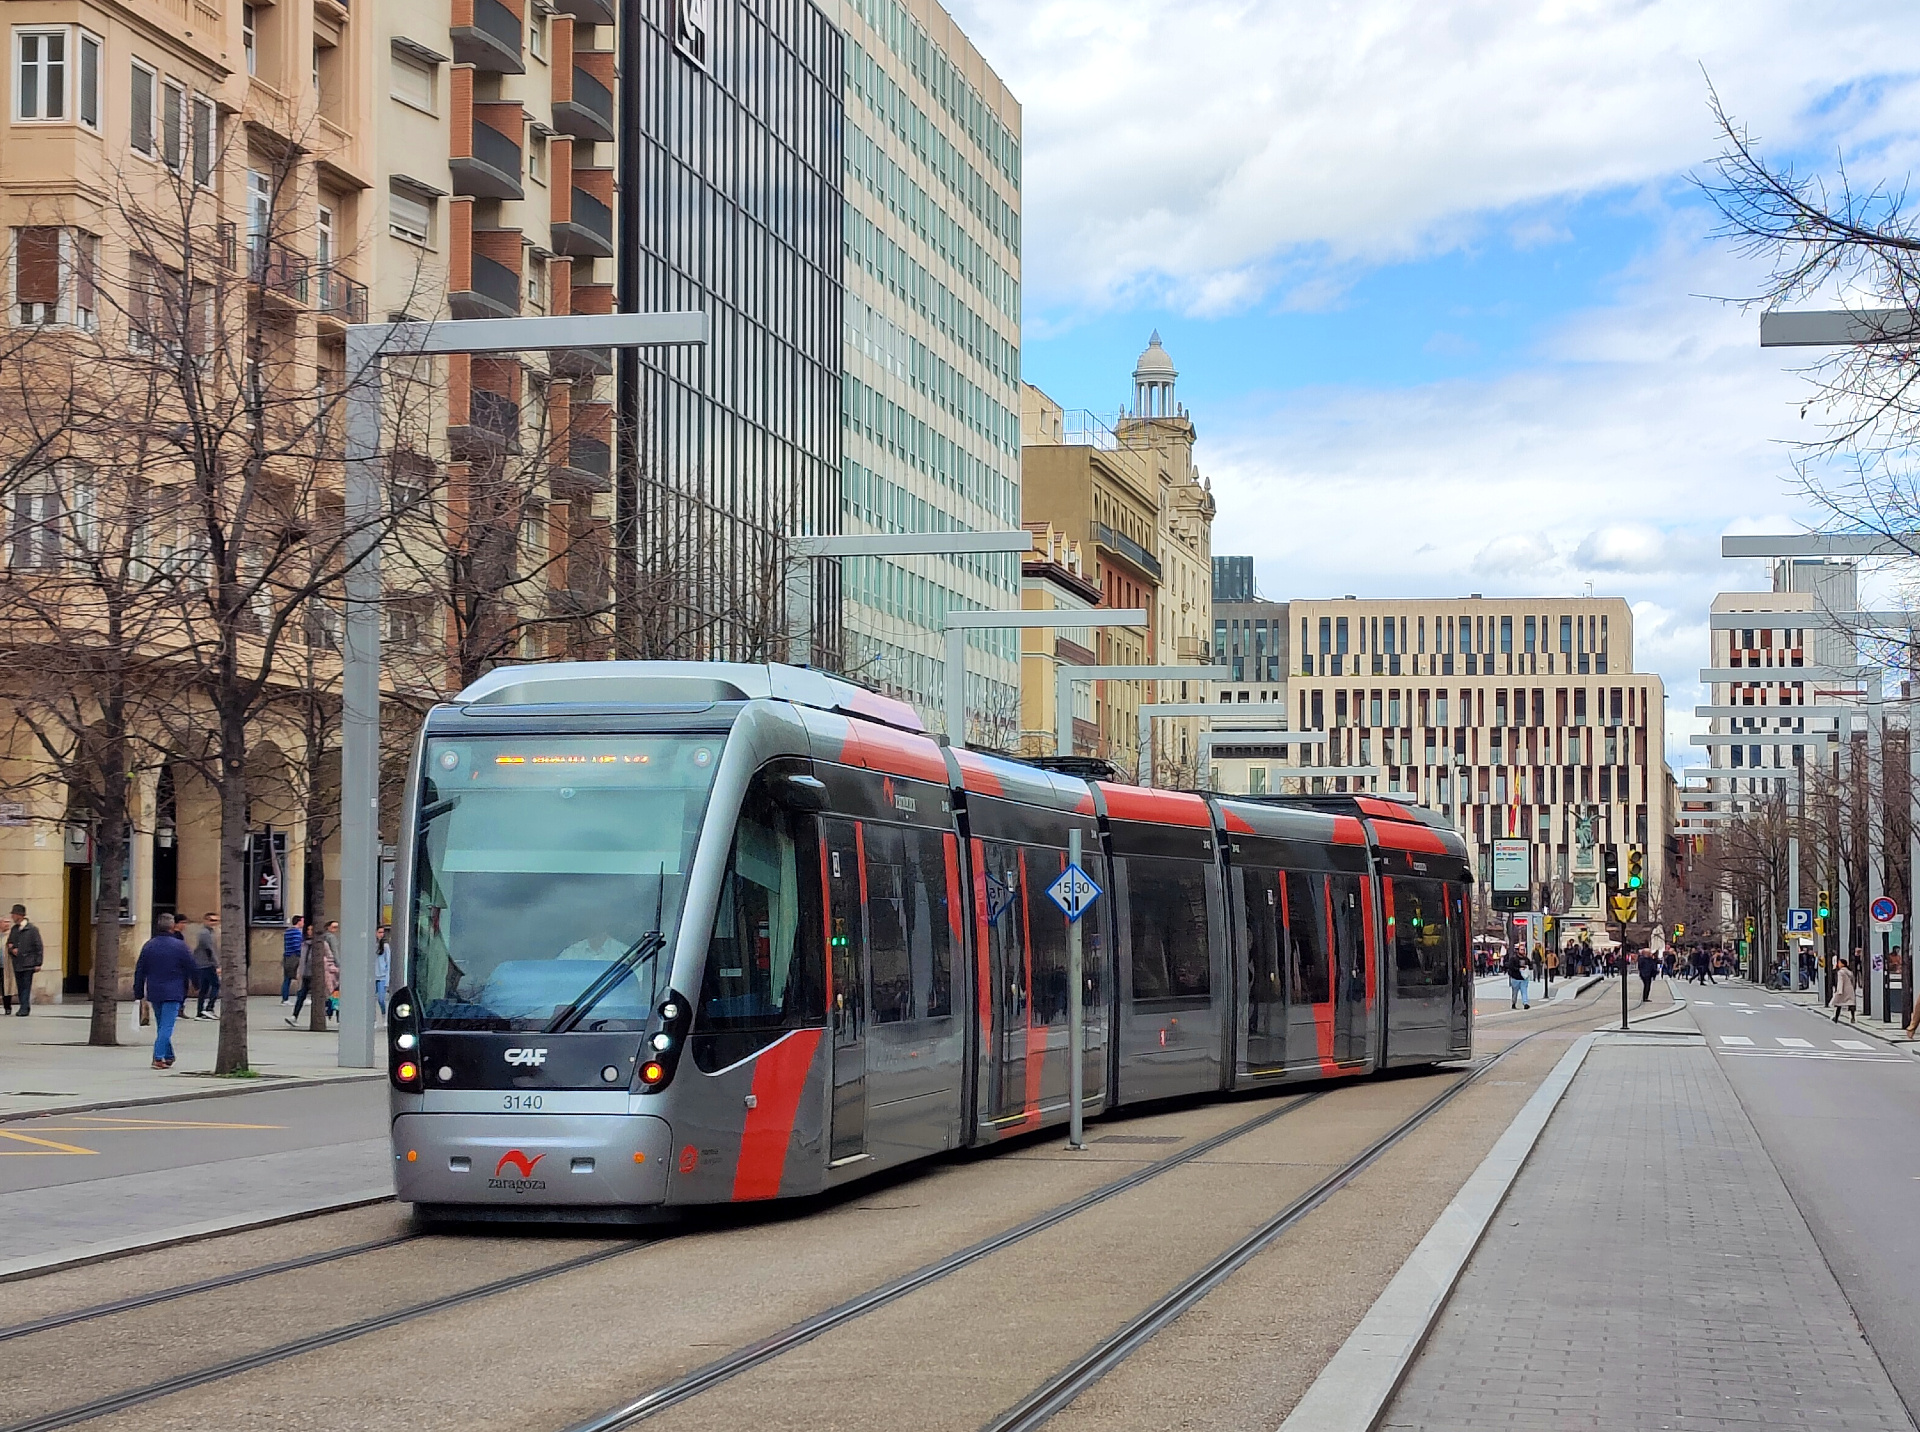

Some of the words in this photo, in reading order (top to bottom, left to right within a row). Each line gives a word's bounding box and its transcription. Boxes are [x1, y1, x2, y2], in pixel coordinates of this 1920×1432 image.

[1057, 882, 1071, 894] 15
[1075, 882, 1090, 894] 30
[1793, 911, 1808, 930] P
[504, 1048, 548, 1066] CAF
[503, 1095, 543, 1110] 3140
[488, 1178, 546, 1193] zaragoza
